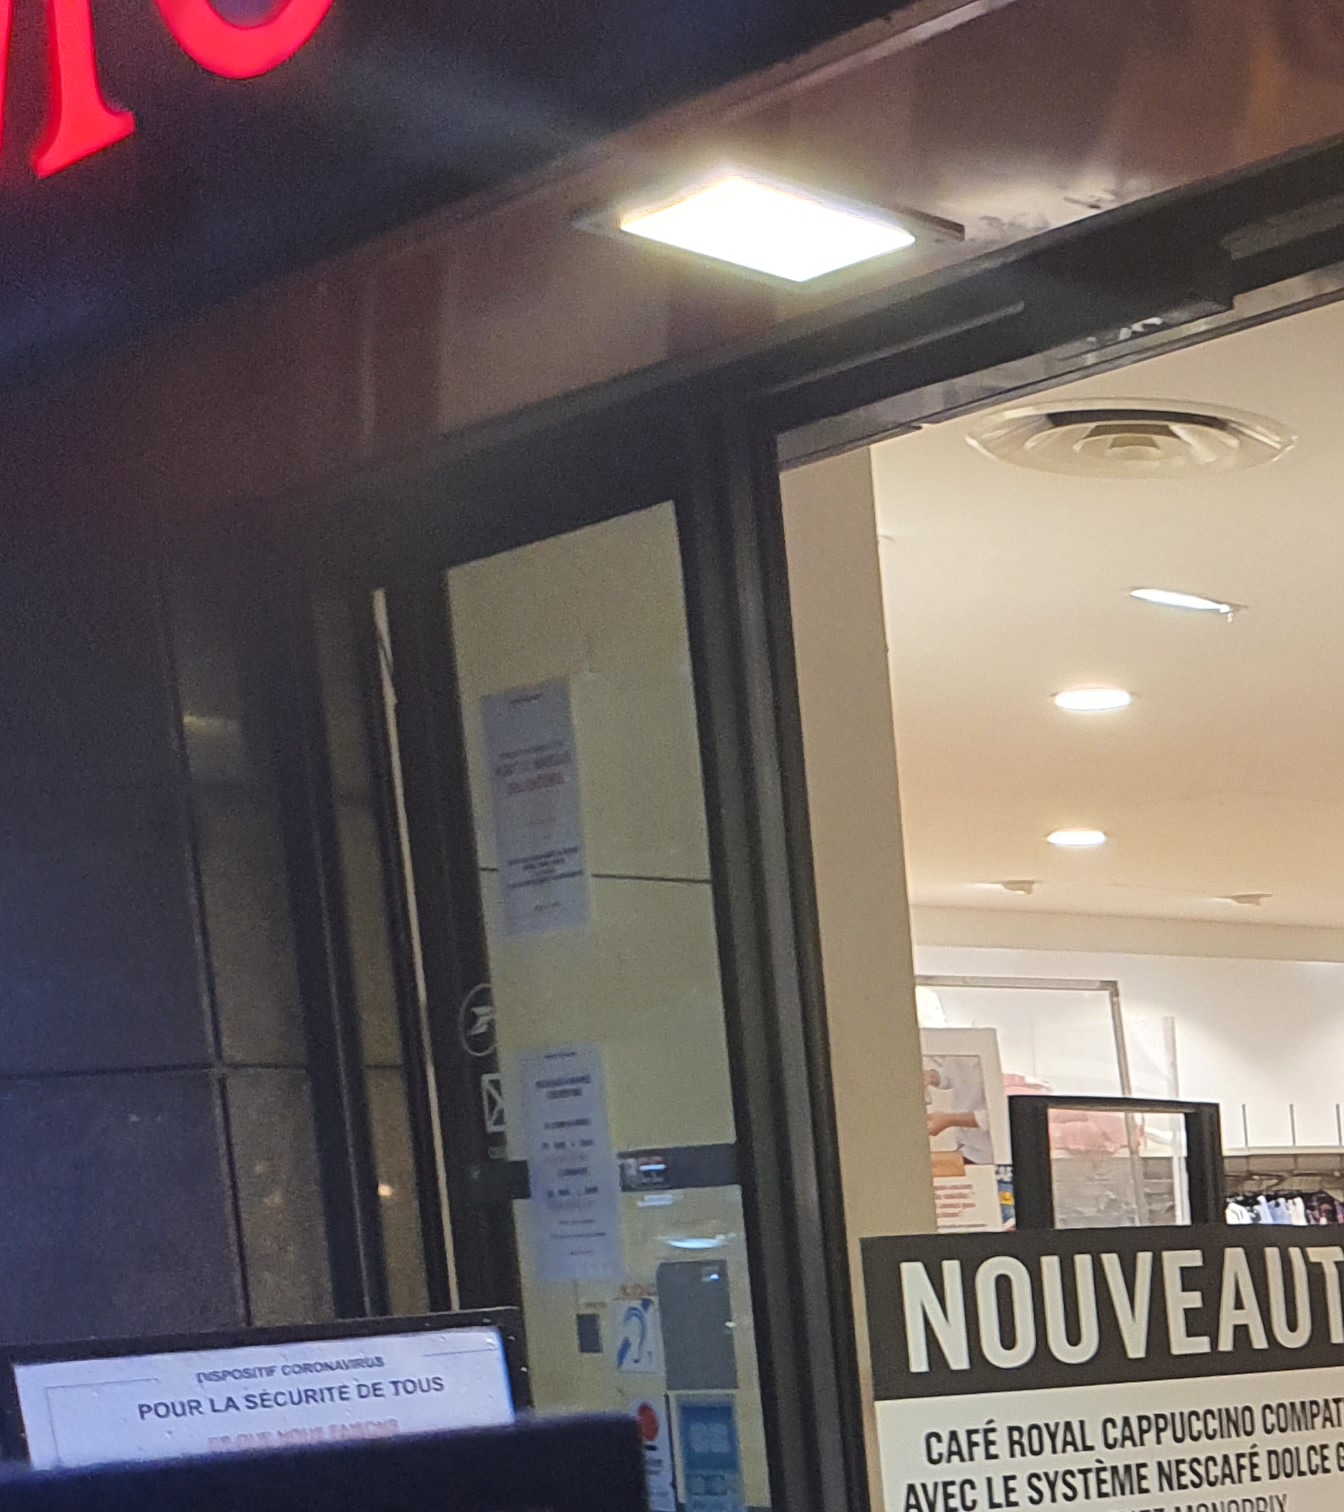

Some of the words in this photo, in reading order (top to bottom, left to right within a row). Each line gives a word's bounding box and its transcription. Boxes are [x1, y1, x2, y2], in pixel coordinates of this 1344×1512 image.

[196, 1365, 276, 1384] DISPOSITIF
[281, 1355, 385, 1377] CORONAVIRUS
[137, 1398, 204, 1420] POUR
[209, 1396, 240, 1414] LA
[357, 1381, 386, 1400] DE
[393, 1375, 445, 1397] TOUS
[925, 1418, 999, 1466] CAFÉ
[1007, 1418, 1095, 1460] ROYAL
[1102, 1405, 1255, 1450] CAPPUCCINO
[986, 1475, 1020, 1510] LE
[1027, 1458, 1151, 1505] SYSTÈME
[1157, 1443, 1262, 1493] NESCAFÉ
[1267, 1443, 1332, 1481] DOLCE
